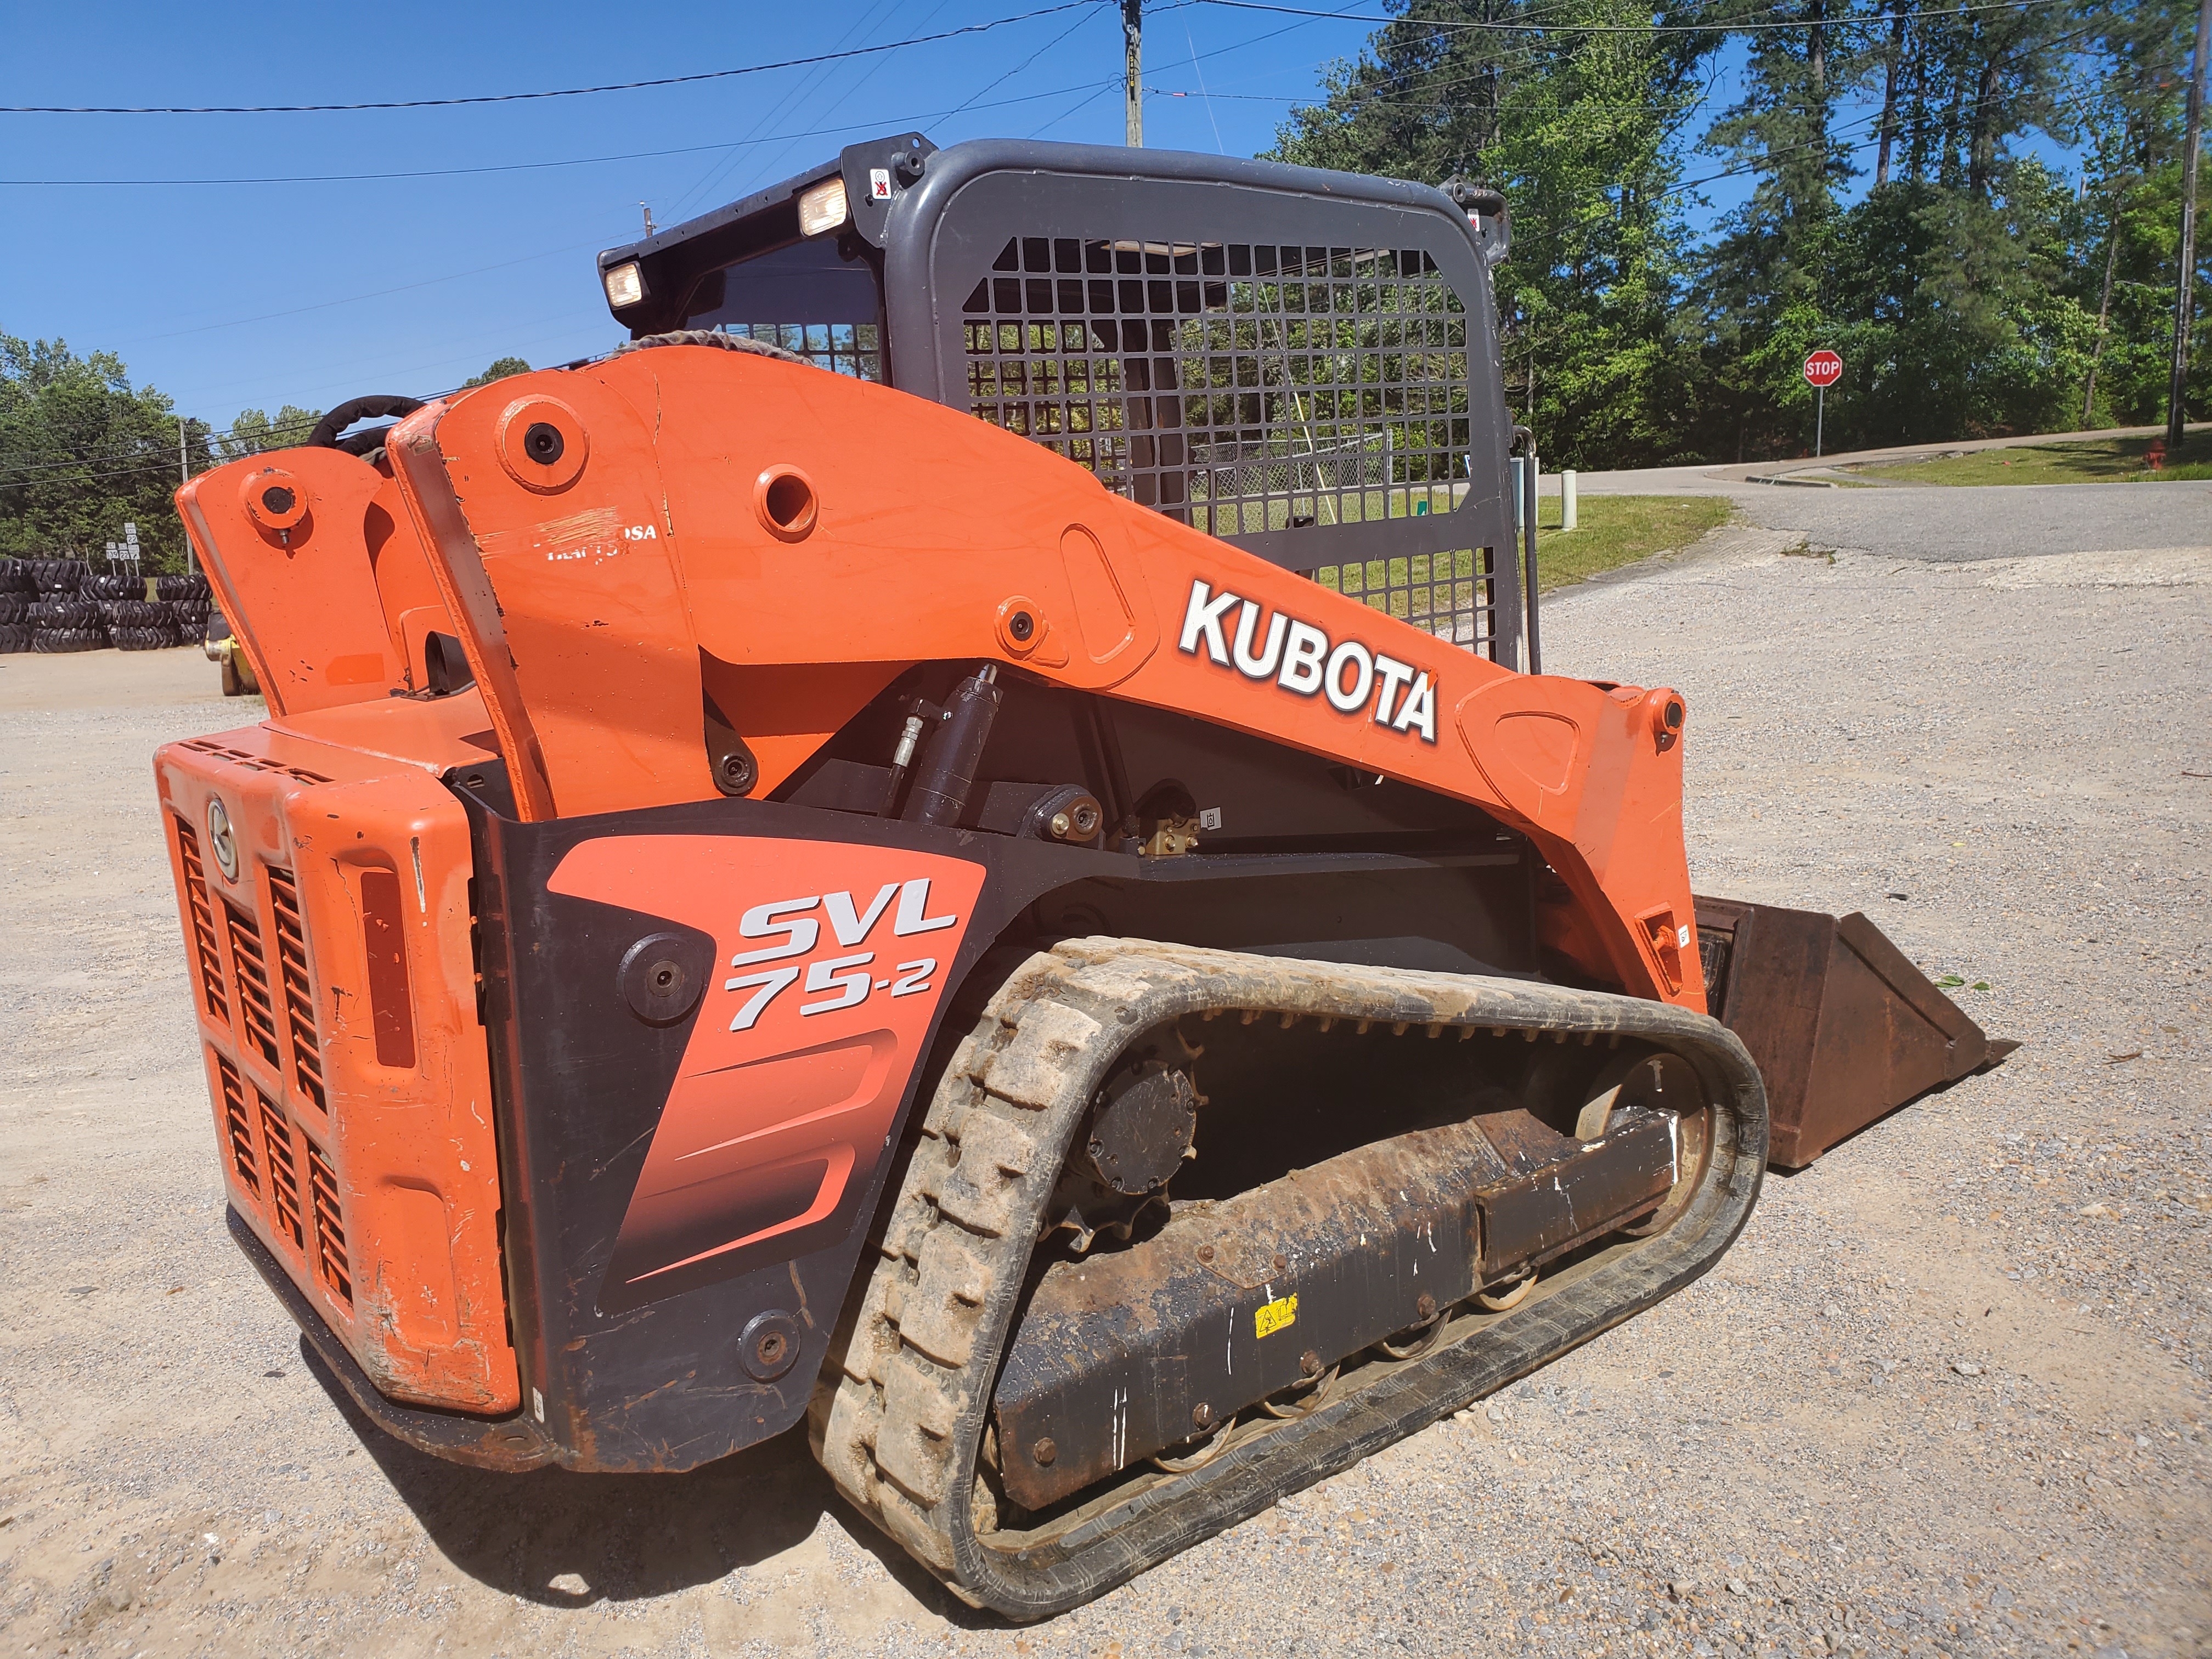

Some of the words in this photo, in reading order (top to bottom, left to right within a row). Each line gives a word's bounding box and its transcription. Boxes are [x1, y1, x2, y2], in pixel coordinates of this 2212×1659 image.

[1806, 361, 1839, 376] STOP
[1178, 579, 1436, 742] KUBOTA
[731, 878, 957, 968] SVL
[725, 952, 937, 1032] 75-2
